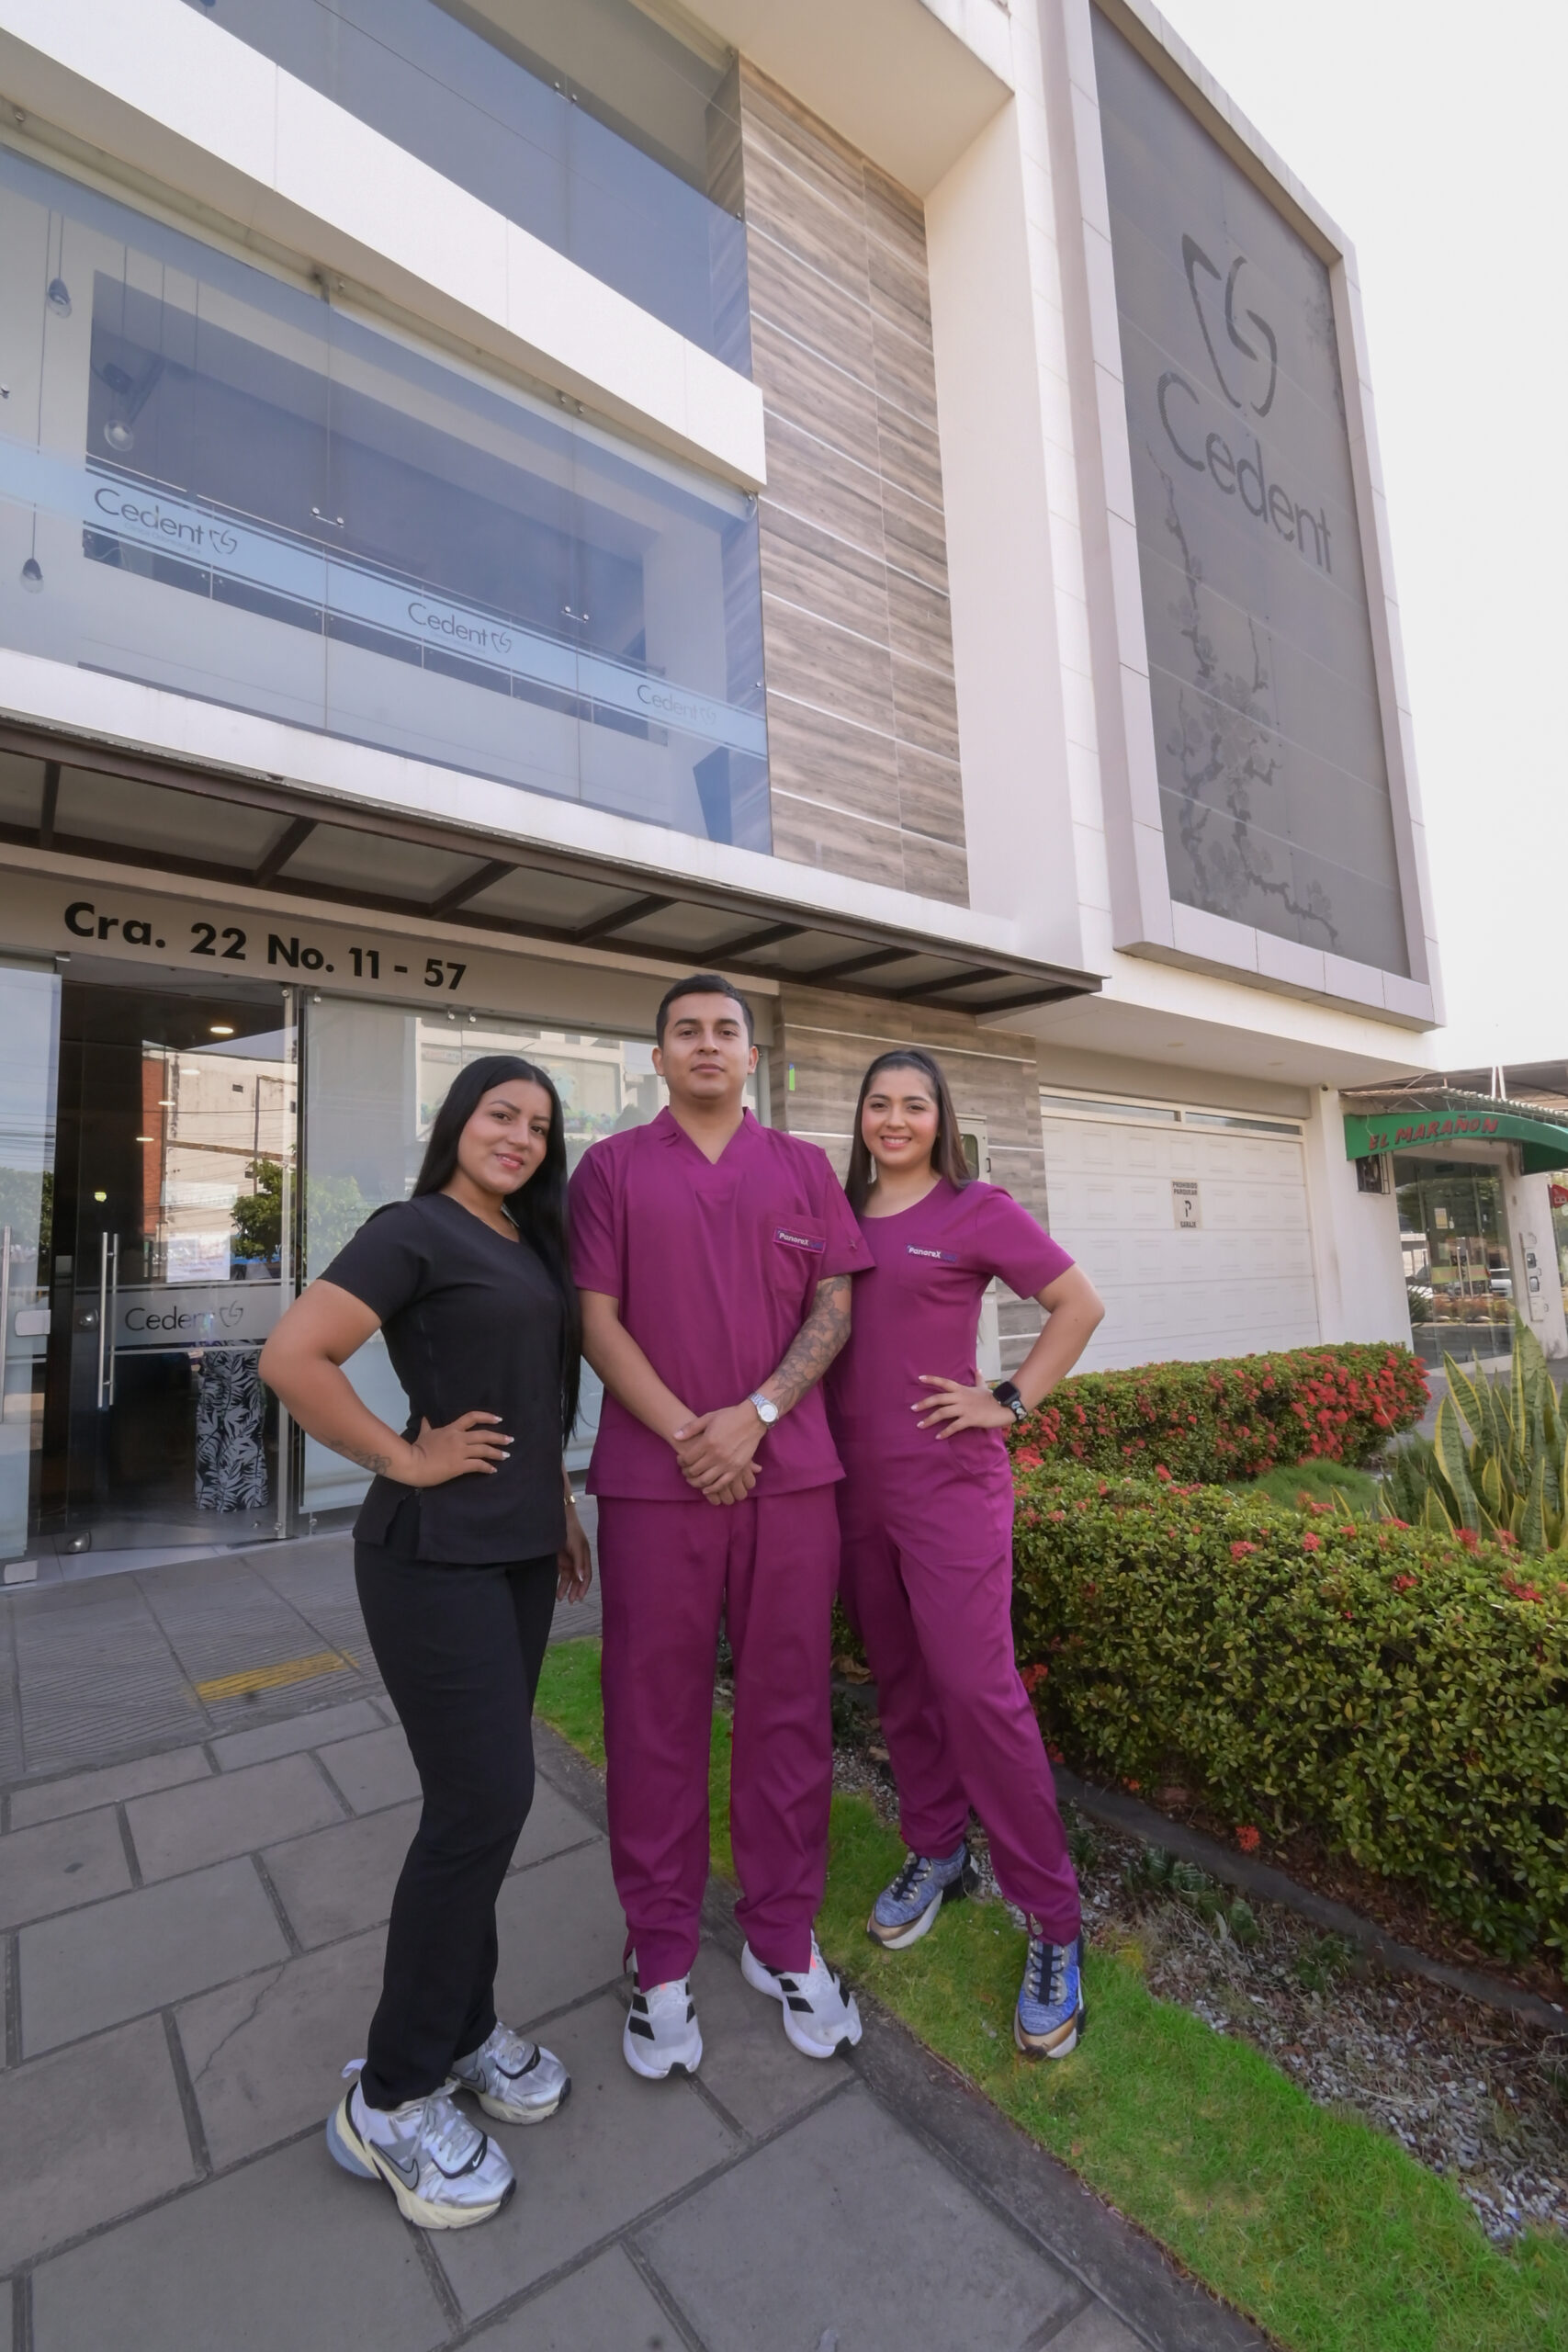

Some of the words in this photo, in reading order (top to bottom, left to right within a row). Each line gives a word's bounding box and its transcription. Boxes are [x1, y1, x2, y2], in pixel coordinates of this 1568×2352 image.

[1157, 371, 1331, 574] Cedent
[94, 488, 204, 545] Cedent
[407, 602, 488, 647] Cedent
[637, 684, 698, 720] Cedent
[64, 901, 166, 948] Cra.
[190, 922, 246, 960] 22
[267, 933, 334, 973] No.
[348, 947, 379, 979] 11
[424, 958, 467, 990] 57
[1369, 1134, 1389, 1150] EL
[1394, 1114, 1498, 1145] MARAÑON
